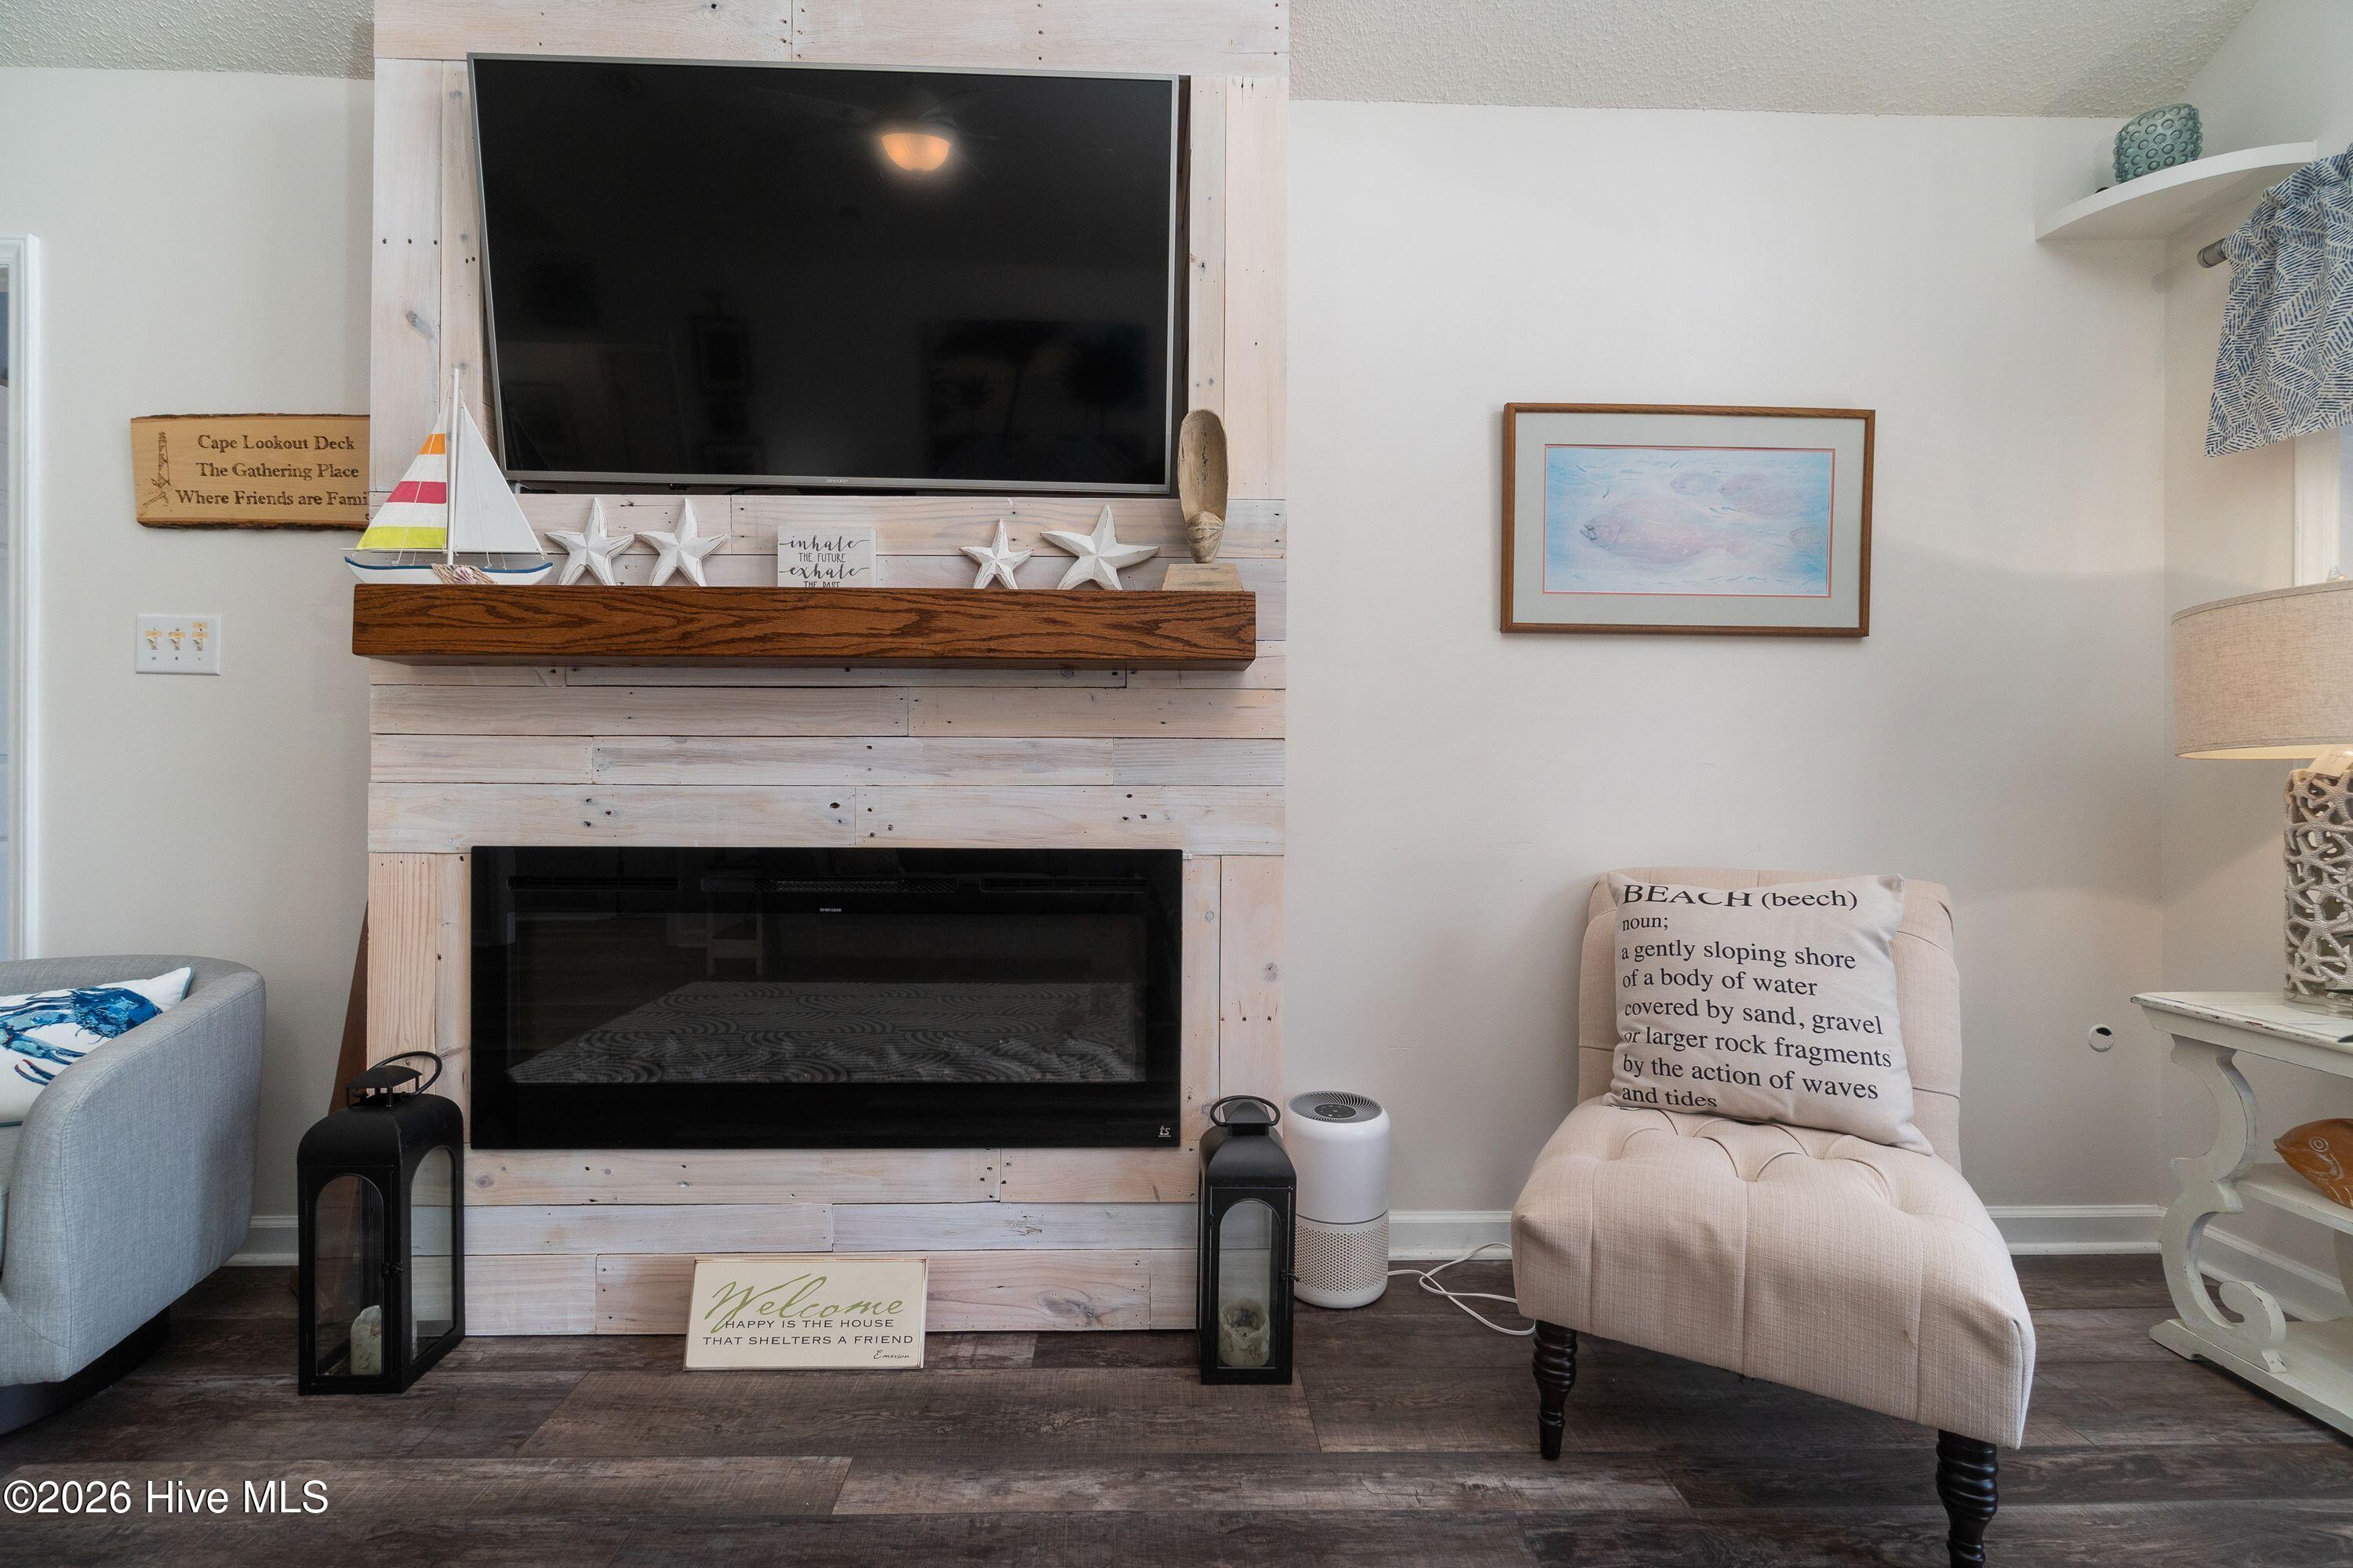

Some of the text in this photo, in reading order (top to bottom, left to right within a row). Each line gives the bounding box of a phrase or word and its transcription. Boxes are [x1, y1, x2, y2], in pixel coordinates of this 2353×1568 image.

[198, 435, 356, 453] Cape Lookout Deck
[196, 462, 359, 480] The Gathering Place
[175, 489, 369, 506] Where Friends are Fami
[779, 535, 869, 551] inhale
[798, 552, 846, 563] THE FUTURE
[779, 563, 869, 579] exhale
[1622, 884, 1858, 911] BEACH (beech)
[1622, 915, 1669, 931] noun;
[1621, 939, 1857, 970] a gently sloping shore
[1622, 967, 1818, 996] of a body of water
[1624, 998, 1884, 1035] covered by sand, gravel
[1624, 1027, 1892, 1068] or larger rock fragments
[1623, 1054, 1878, 1100] by the action of waves
[1622, 1086, 1718, 1108] and tides
[704, 1273, 904, 1334] Welcome
[726, 1320, 776, 1329] HAPPY
[802, 1319, 833, 1328] THE
[840, 1319, 894, 1328] HOUSE
[703, 1335, 913, 1345] THAT SHELTERS A FRIEND
[873, 1349, 910, 1359] Emerson
